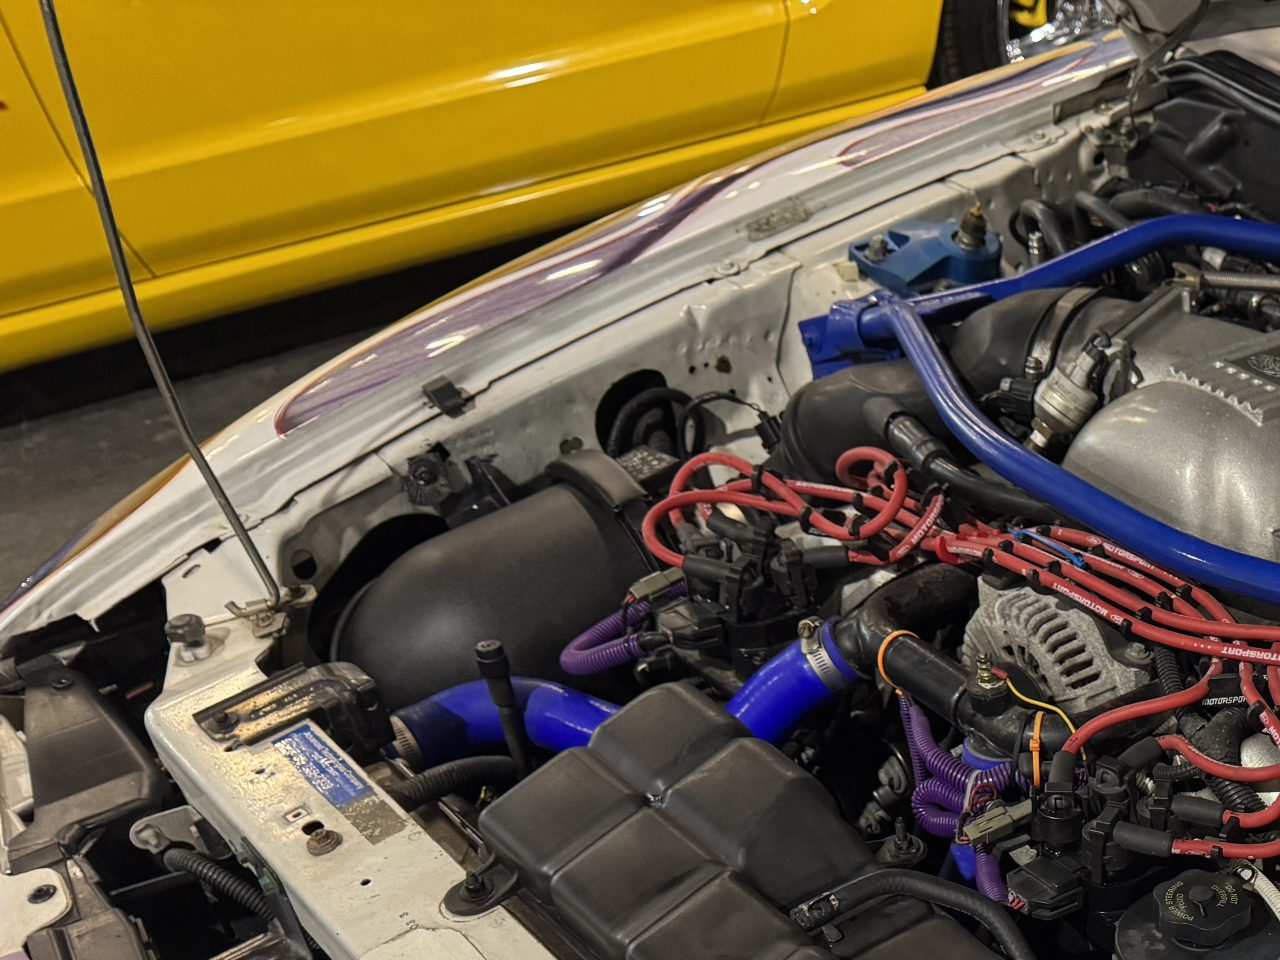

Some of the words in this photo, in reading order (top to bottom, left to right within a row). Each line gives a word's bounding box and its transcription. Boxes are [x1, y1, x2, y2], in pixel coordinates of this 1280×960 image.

[1053, 582, 1109, 616] MOTORSPORT
[1165, 880, 1184, 905] STEERING
[1168, 906, 1195, 921] POWER
